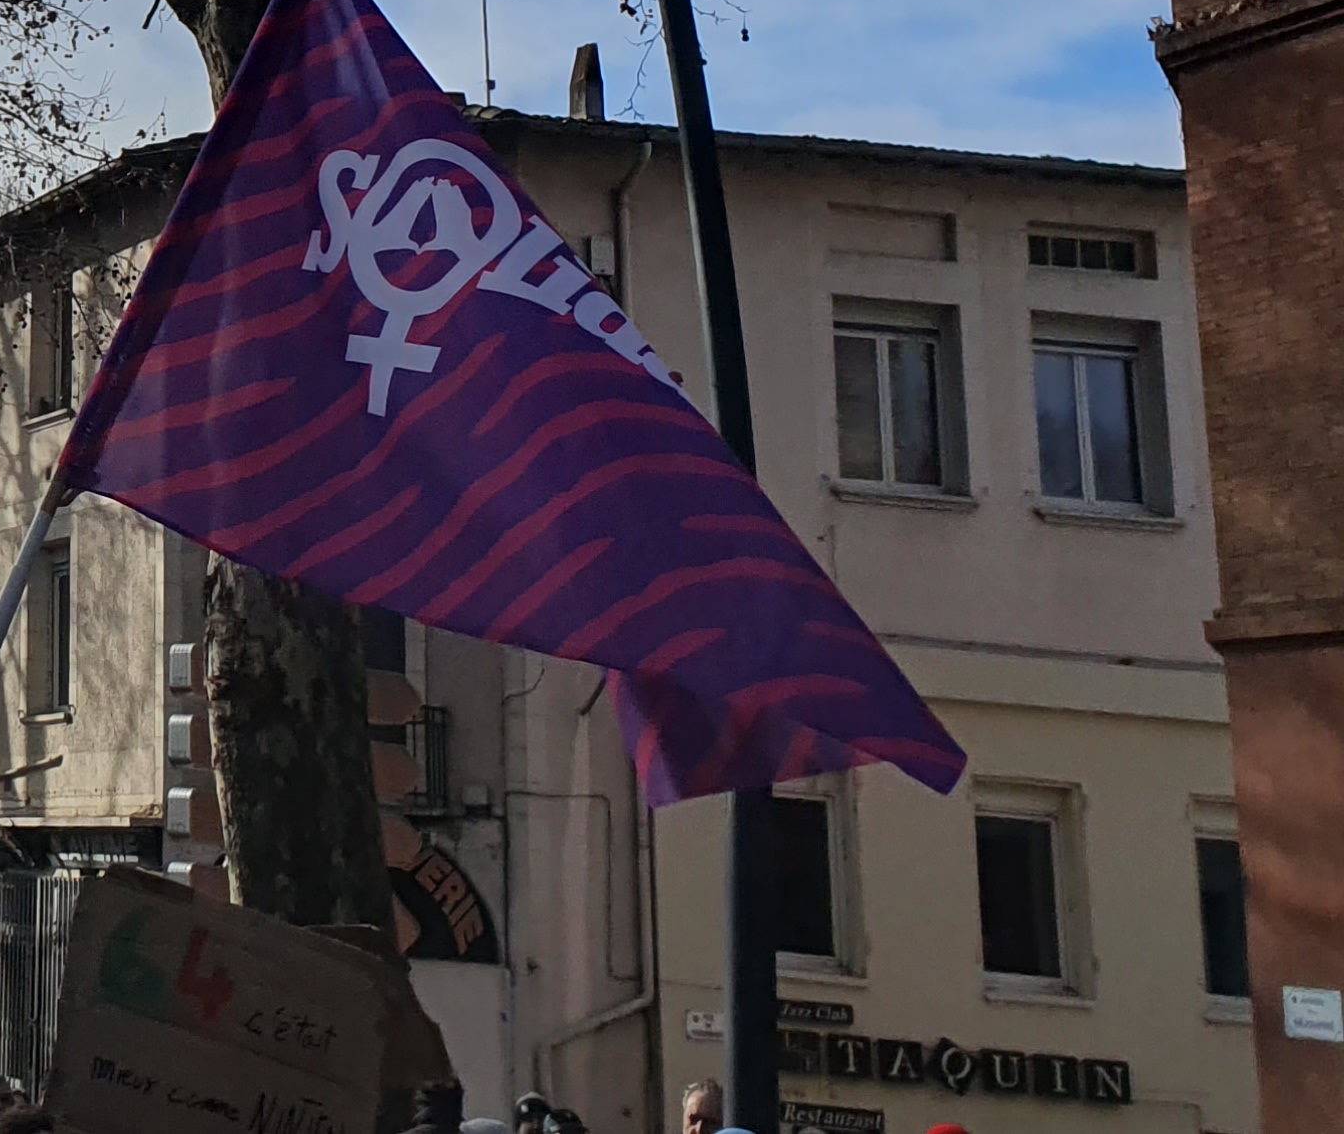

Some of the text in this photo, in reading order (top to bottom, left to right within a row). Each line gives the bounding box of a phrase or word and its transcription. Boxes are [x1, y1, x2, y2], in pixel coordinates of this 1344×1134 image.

[97, 905, 237, 1024] 64
[816, 1006, 849, 1021] Club
[837, 1039, 1123, 1098] TAQUIN
[783, 1103, 882, 1129] Restaurant
